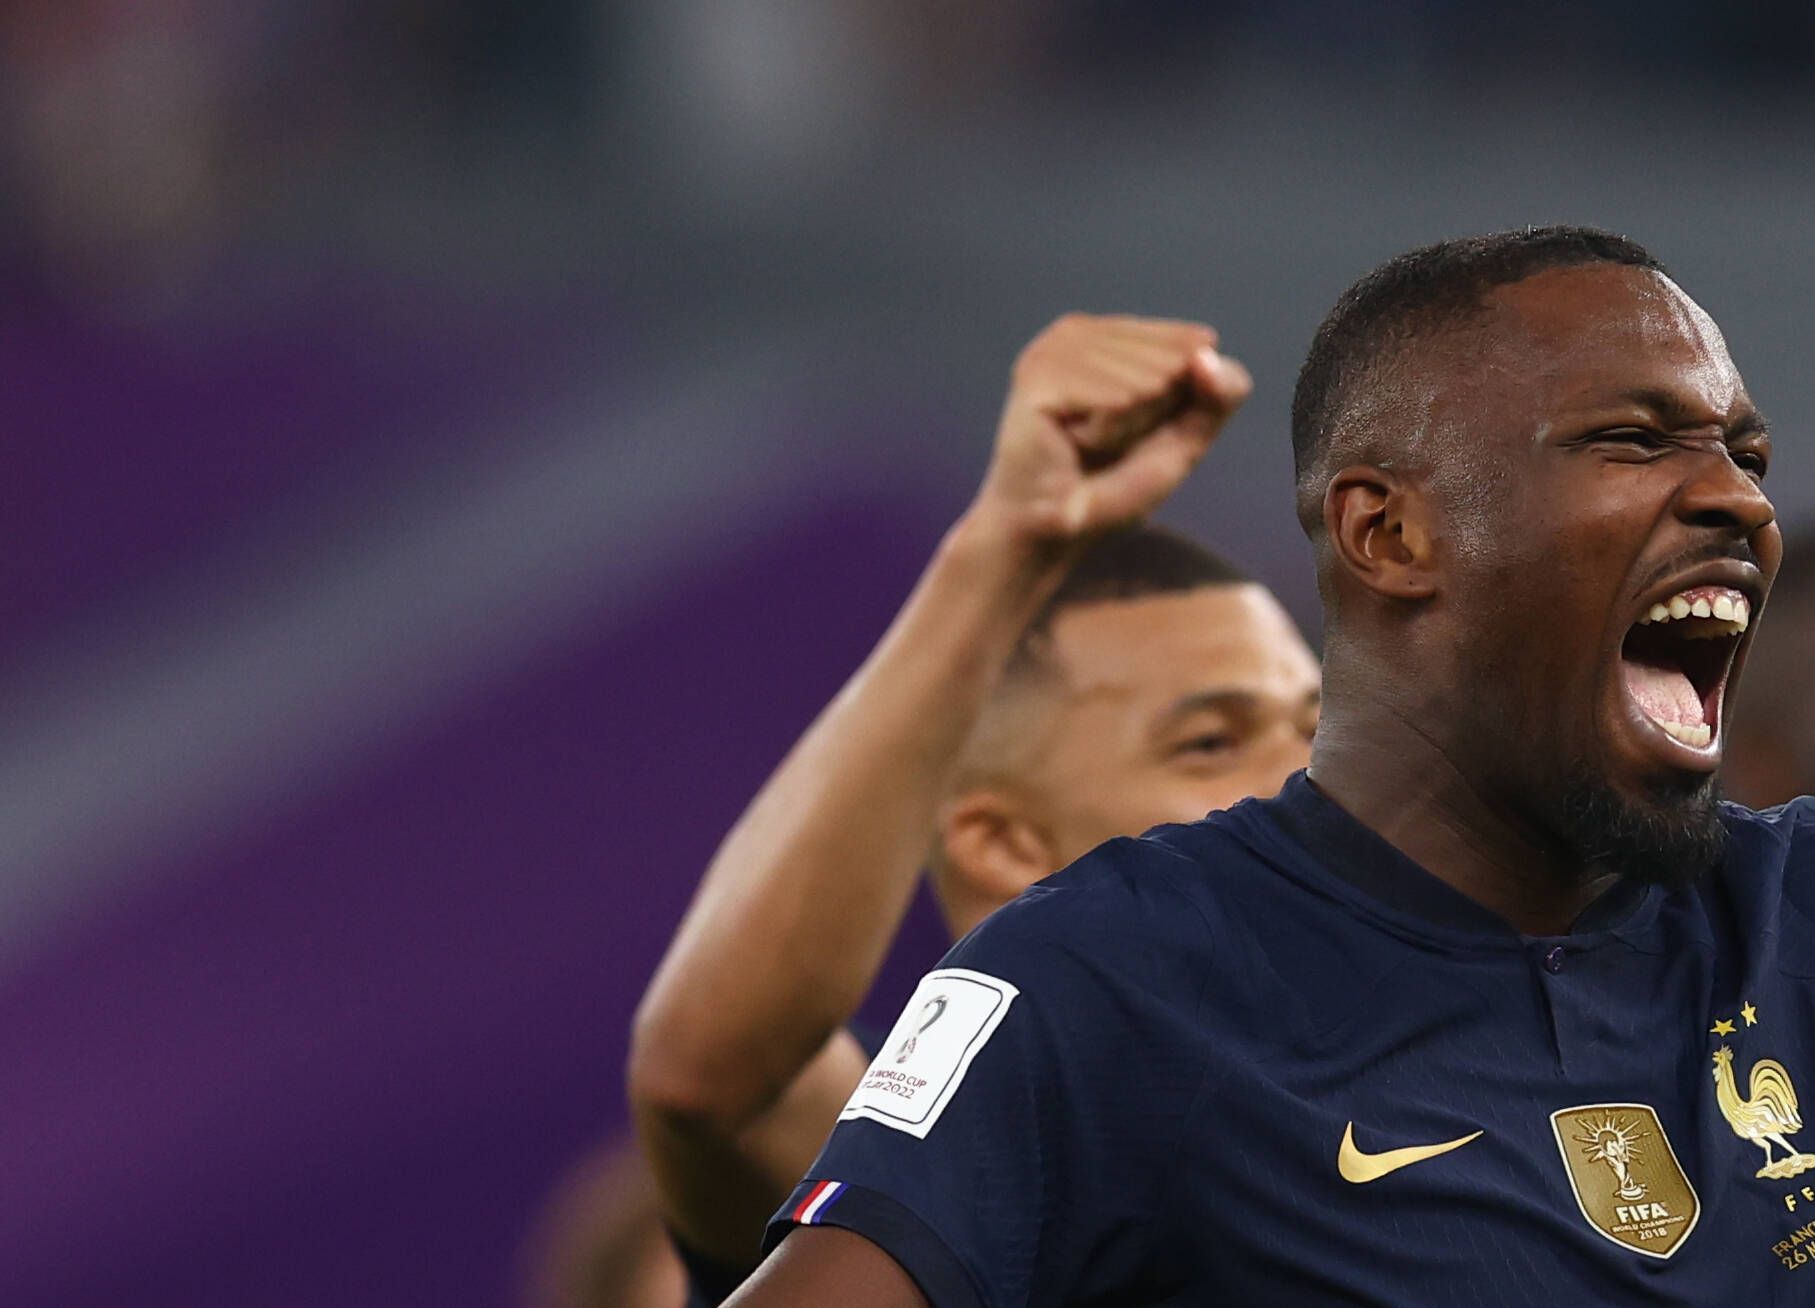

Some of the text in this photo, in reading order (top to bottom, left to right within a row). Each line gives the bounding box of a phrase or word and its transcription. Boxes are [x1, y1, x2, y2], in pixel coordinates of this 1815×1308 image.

[875, 1070, 906, 1082] WORLD
[906, 1076, 928, 1088] CUP
[882, 1081, 915, 1100] 2022
[1616, 1202, 1669, 1224] FIFA
[1611, 1223, 1639, 1233] WORLD
[1638, 1227, 1668, 1241] 2018
[1782, 1248, 1808, 1270] 26
